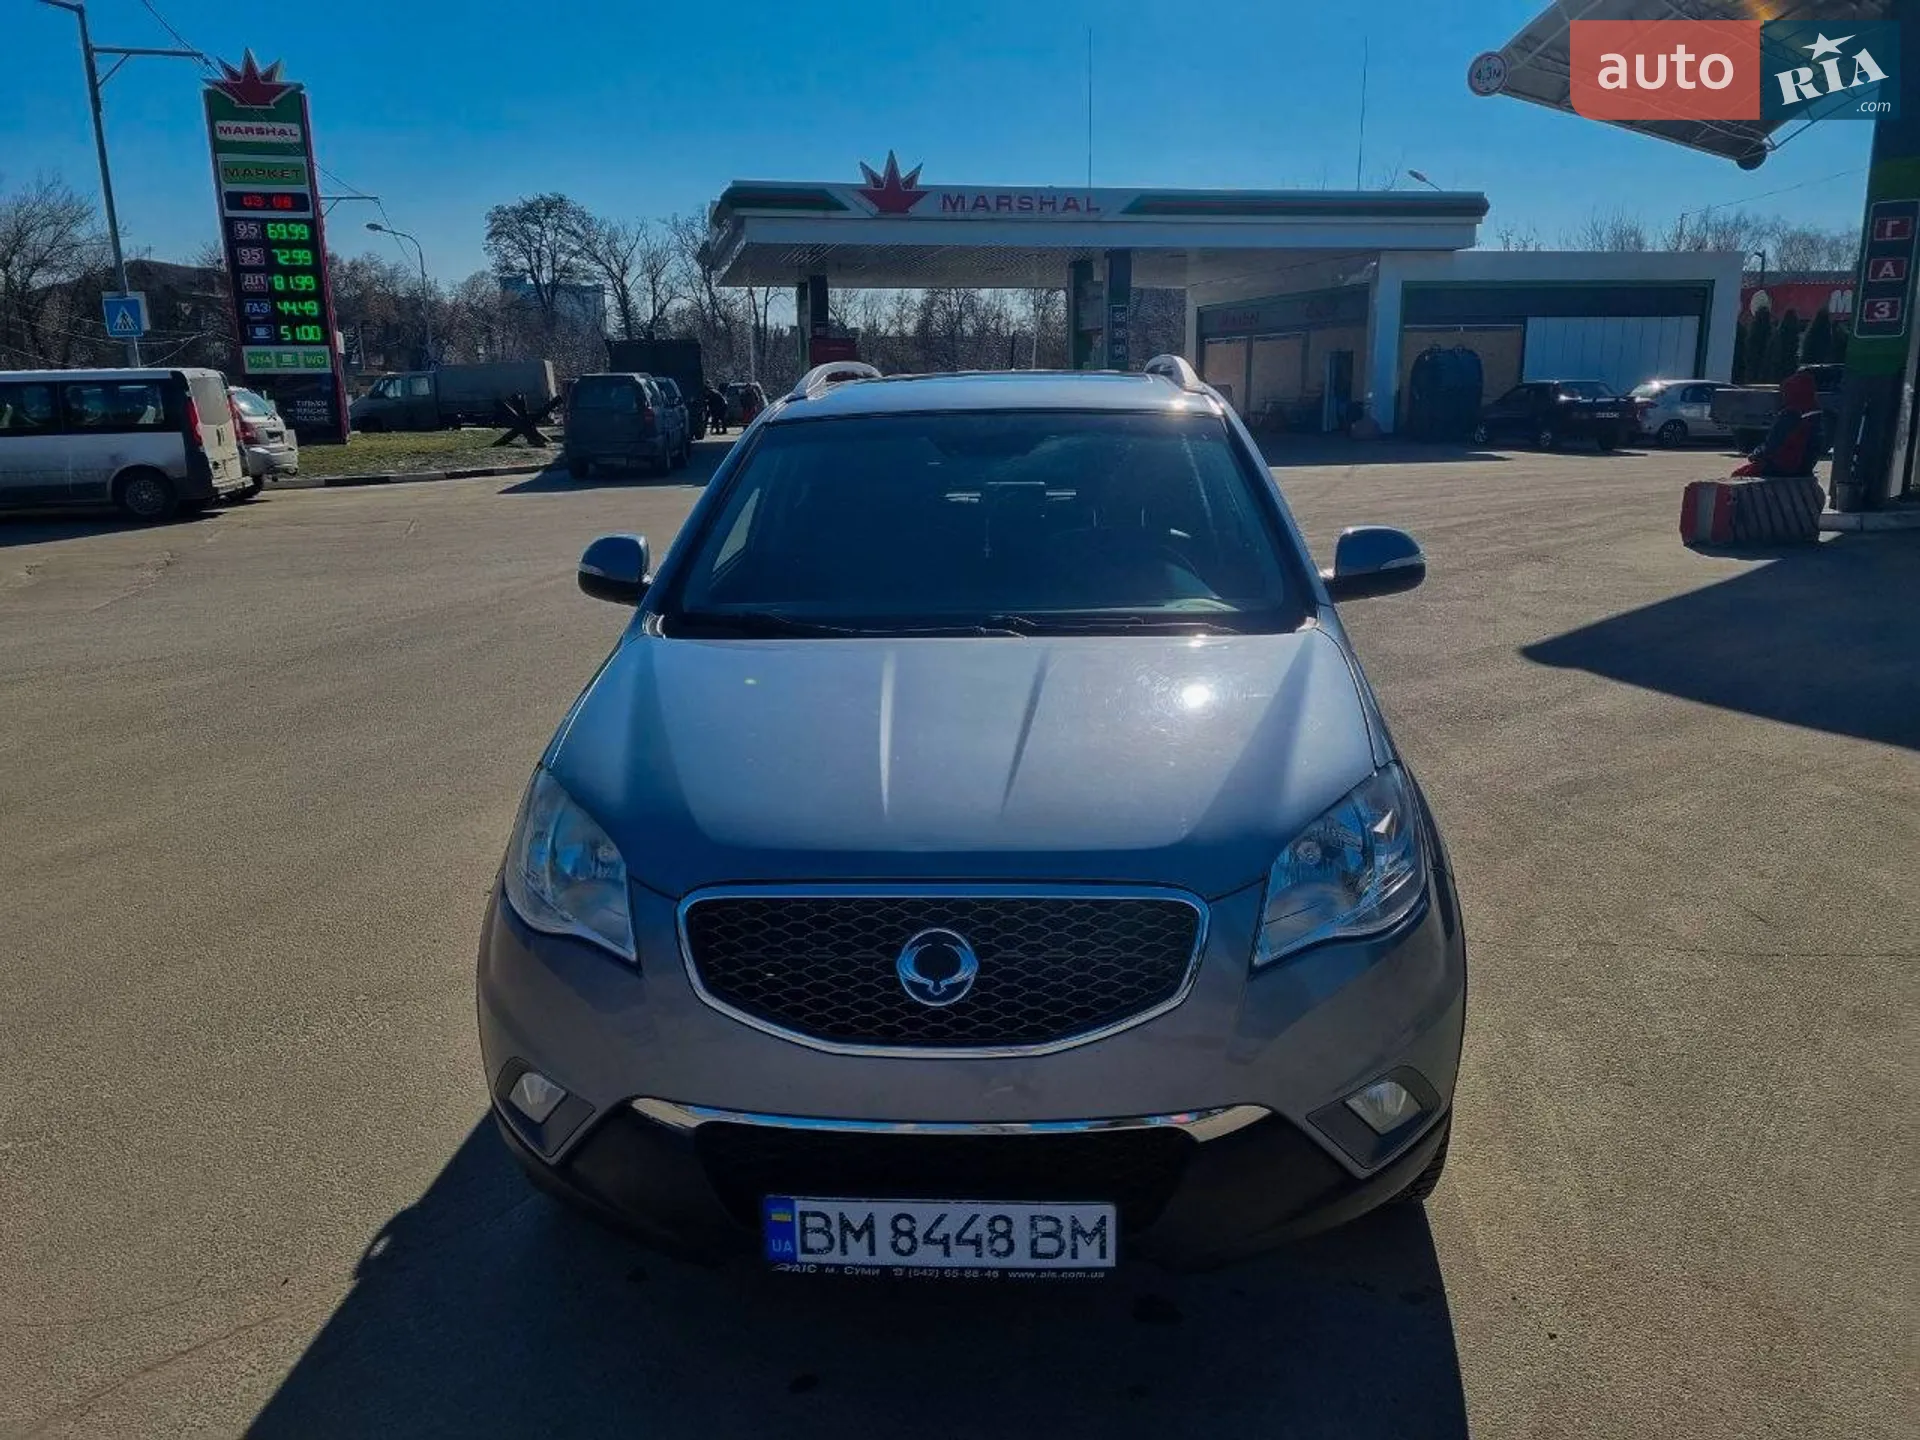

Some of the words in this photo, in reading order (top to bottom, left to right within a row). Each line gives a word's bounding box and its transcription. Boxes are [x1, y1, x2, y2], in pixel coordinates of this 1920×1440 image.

[217, 126, 299, 137] MARSHAL
[223, 168, 301, 179] MARKET
[940, 193, 1102, 213] MARSHAL
[245, 302, 269, 313] ГАЗ
[798, 1210, 877, 1257] BM
[890, 1213, 1015, 1259] 8448
[1029, 1214, 1108, 1260] BM
[772, 1239, 793, 1253] UA
